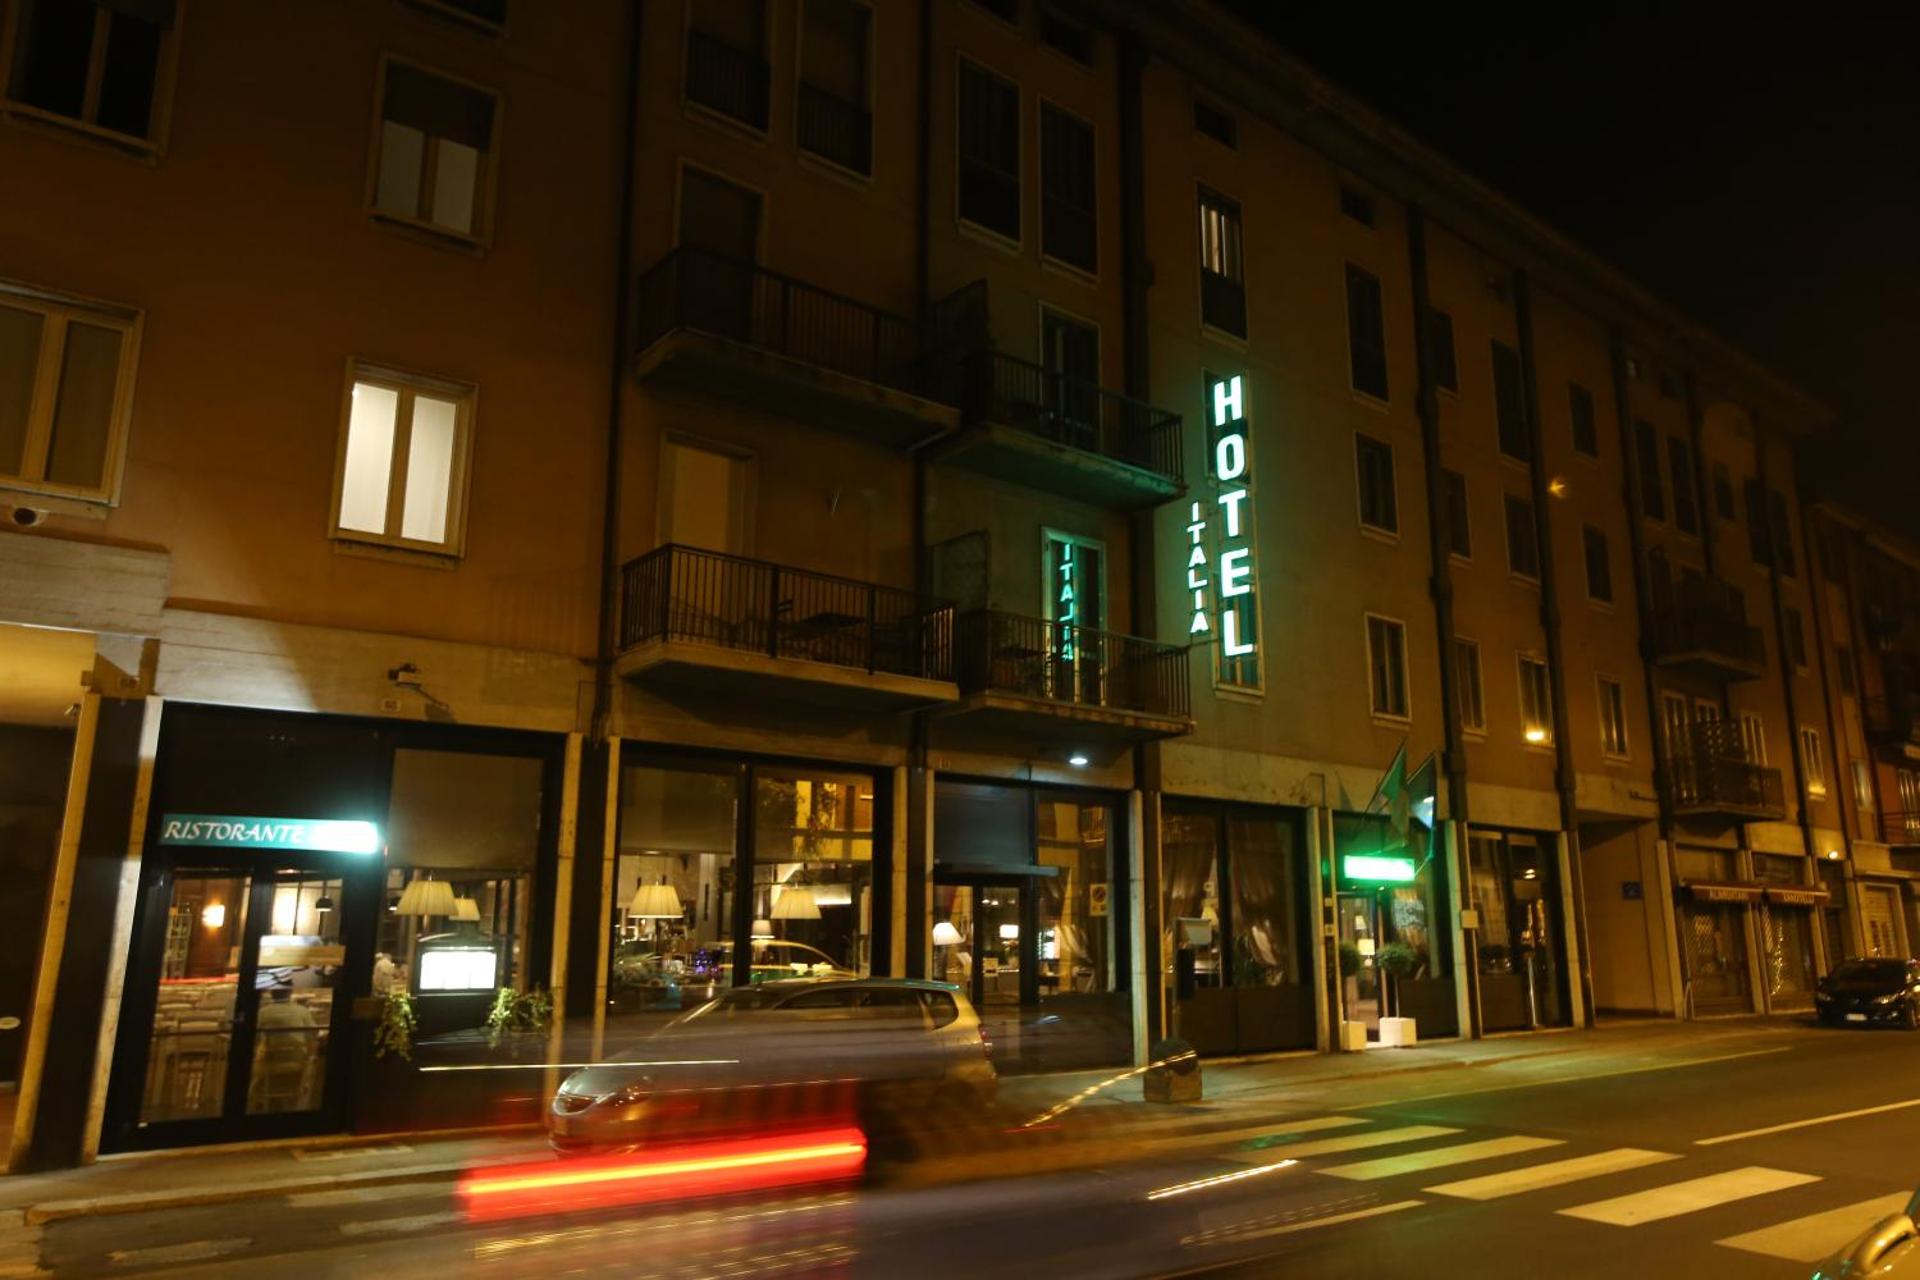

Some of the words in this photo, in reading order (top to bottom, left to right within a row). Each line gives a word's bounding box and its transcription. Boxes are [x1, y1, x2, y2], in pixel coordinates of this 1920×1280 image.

[1186, 502, 1209, 633] ITALIA
[1213, 375, 1253, 657] HOTEL
[164, 820, 304, 843] RISTORANTE
